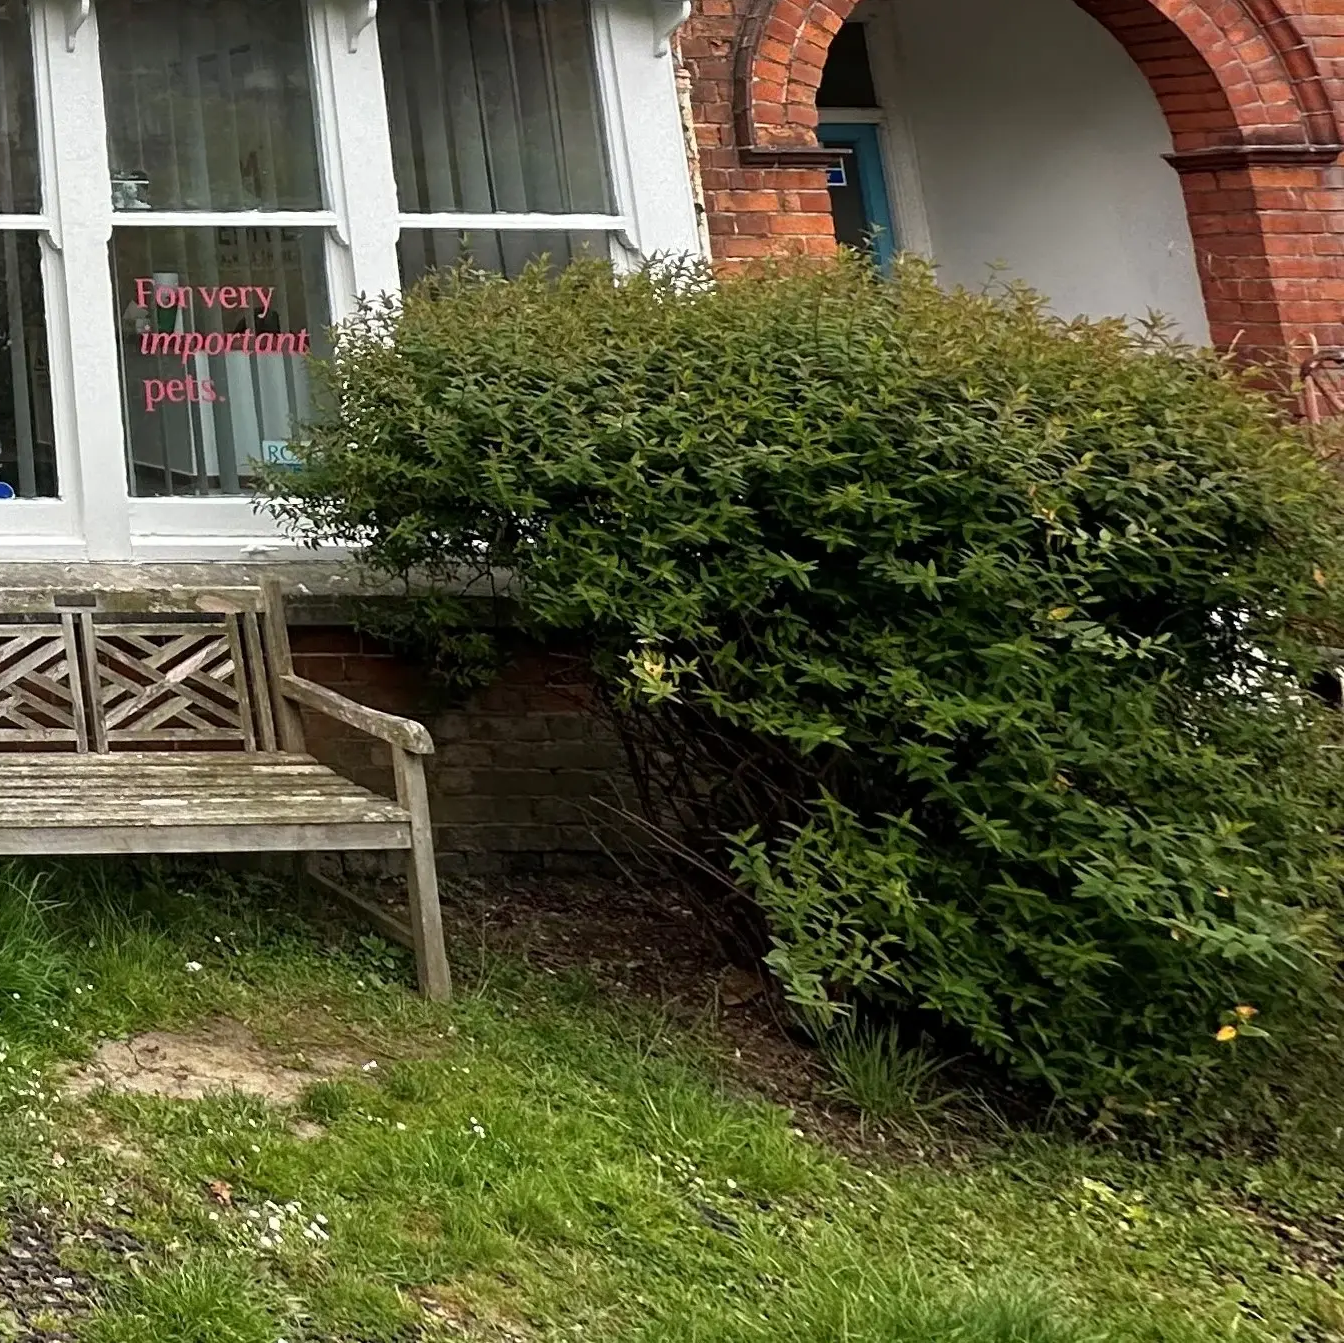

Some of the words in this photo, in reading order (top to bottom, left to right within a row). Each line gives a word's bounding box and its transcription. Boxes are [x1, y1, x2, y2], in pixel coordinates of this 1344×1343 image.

[134, 278, 193, 309] For
[198, 286, 275, 318] very
[140, 325, 310, 364] important
[143, 375, 226, 412] pets.
